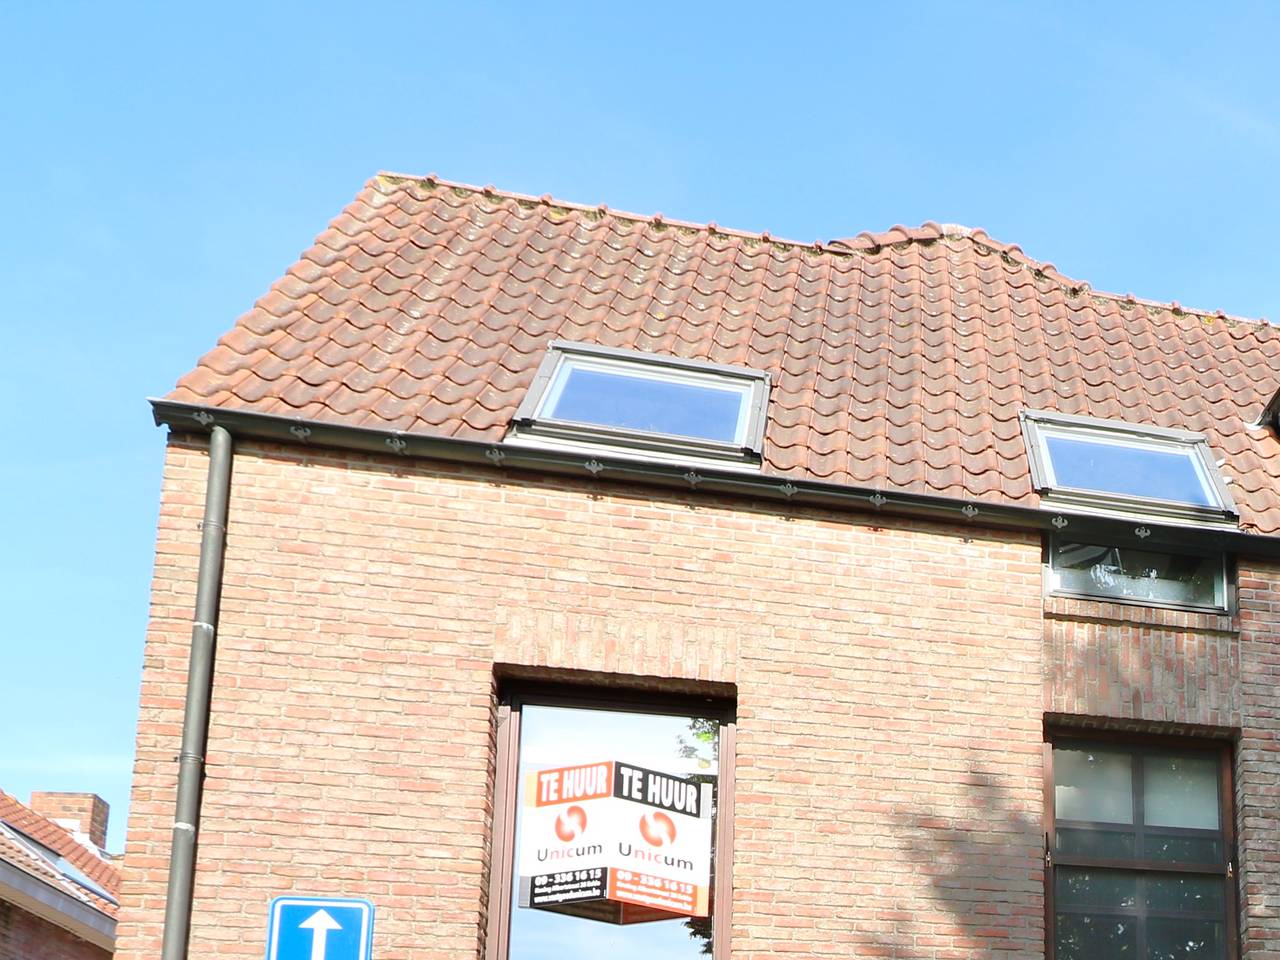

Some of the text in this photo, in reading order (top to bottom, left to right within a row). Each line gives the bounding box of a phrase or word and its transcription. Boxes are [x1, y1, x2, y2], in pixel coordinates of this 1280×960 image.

[540, 765, 609, 802] TE HUUR
[620, 766, 698, 814] TE HUUR
[537, 844, 603, 862] Unicum
[618, 842, 694, 871] Unicum
[534, 875, 549, 886] 09
[553, 871, 574, 883] 336
[574, 870, 588, 881] 16
[588, 868, 602, 879] 15
[664, 880, 678, 891] 16
[679, 884, 693, 894] 15
